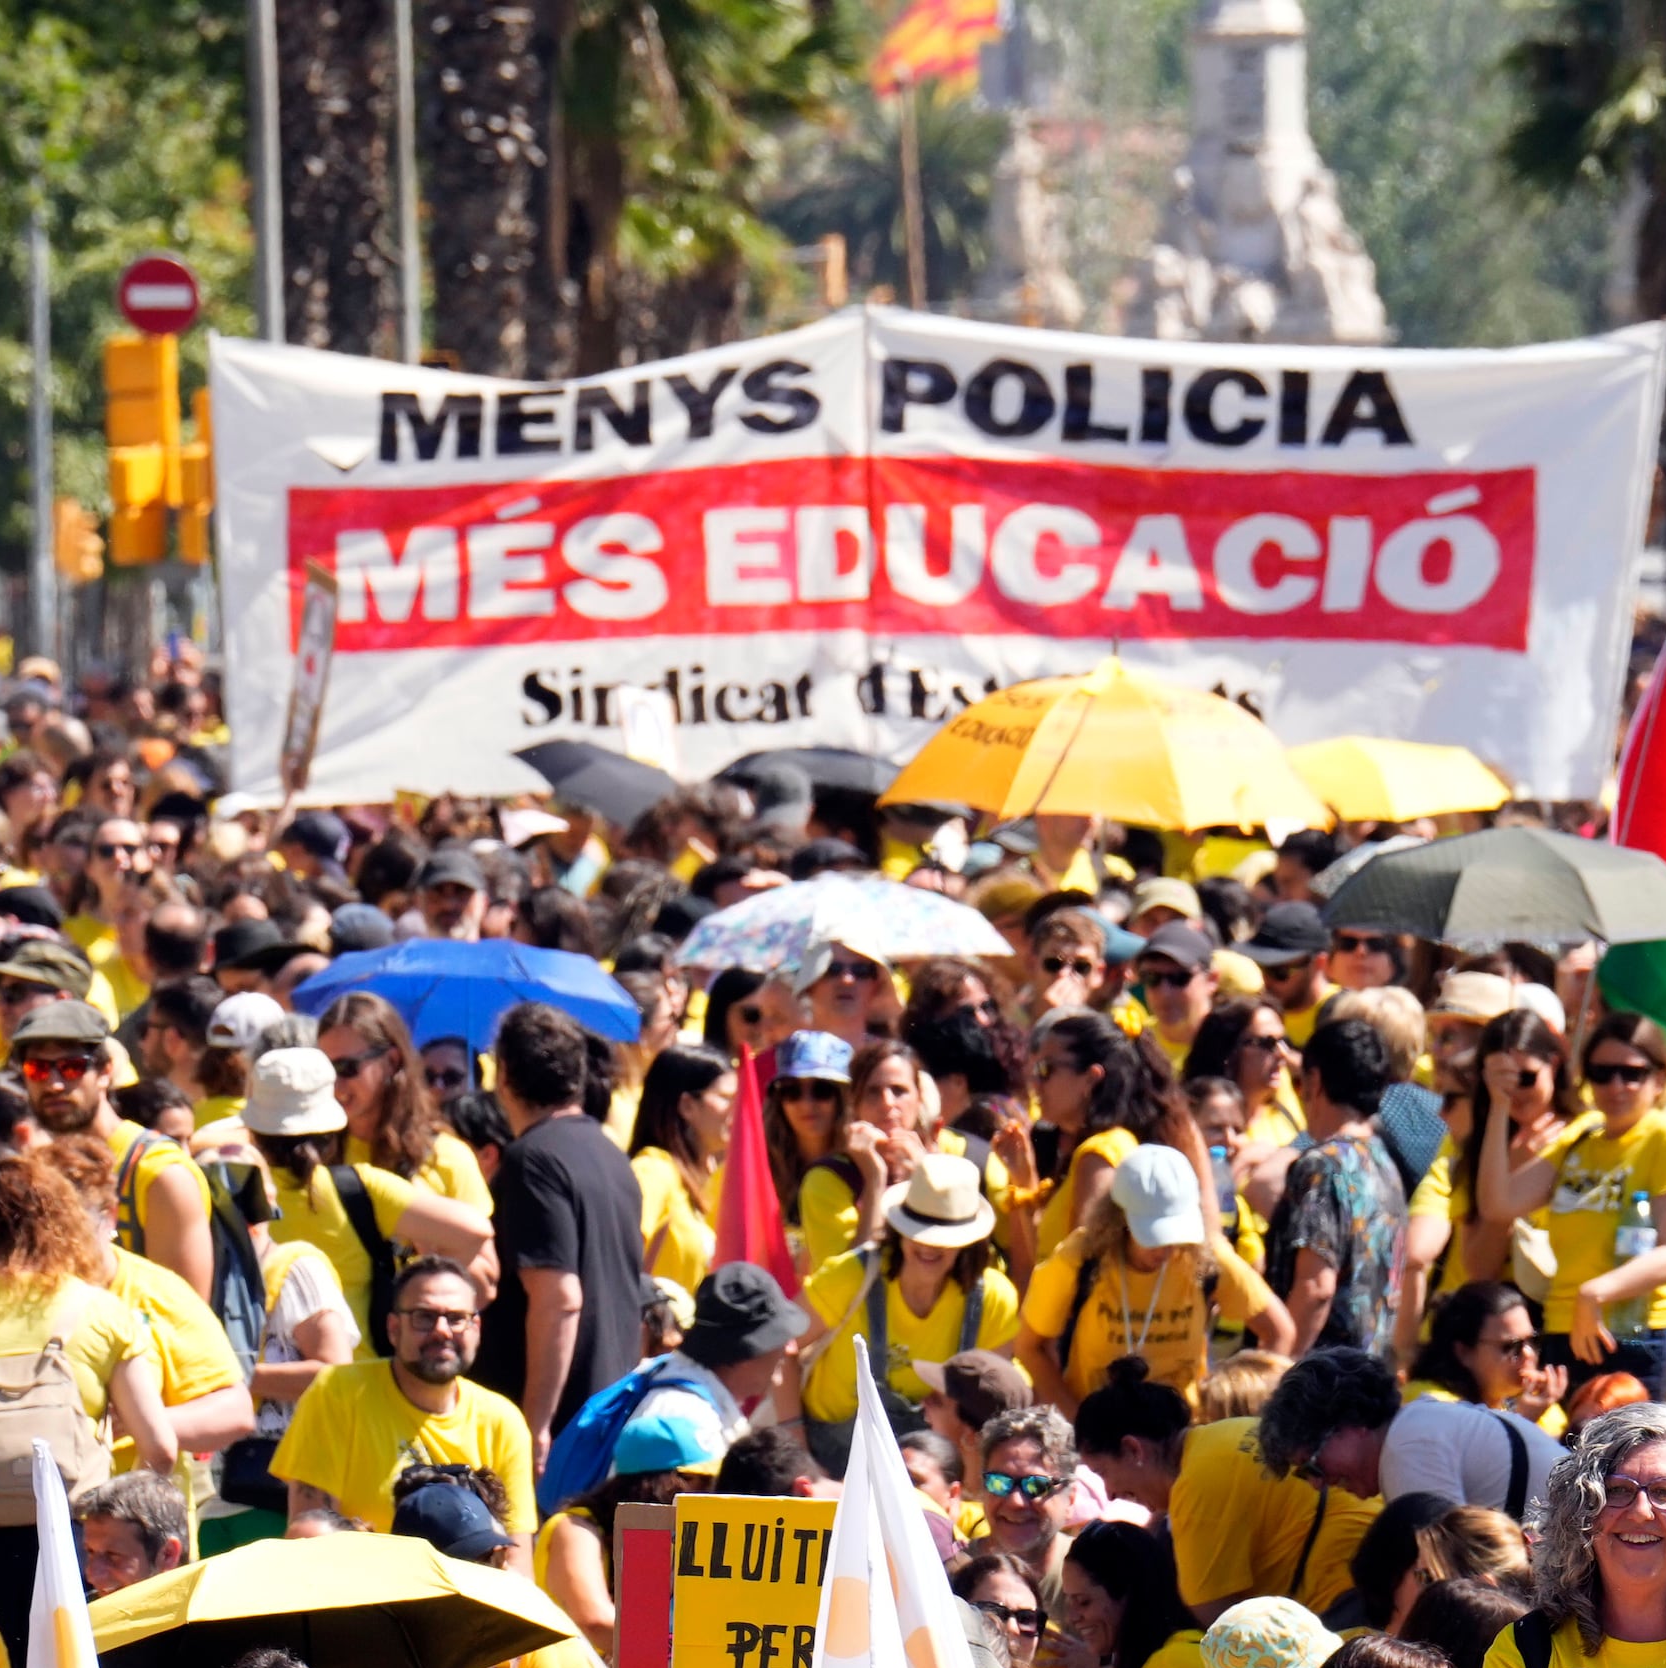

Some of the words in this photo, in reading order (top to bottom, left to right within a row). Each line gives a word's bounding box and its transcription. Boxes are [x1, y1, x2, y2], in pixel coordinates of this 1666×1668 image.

[376, 356, 823, 464] MENYS
[877, 357, 1419, 449] POLICIA
[334, 496, 671, 616] MÉS
[703, 484, 1503, 616] EDUCACIÓ
